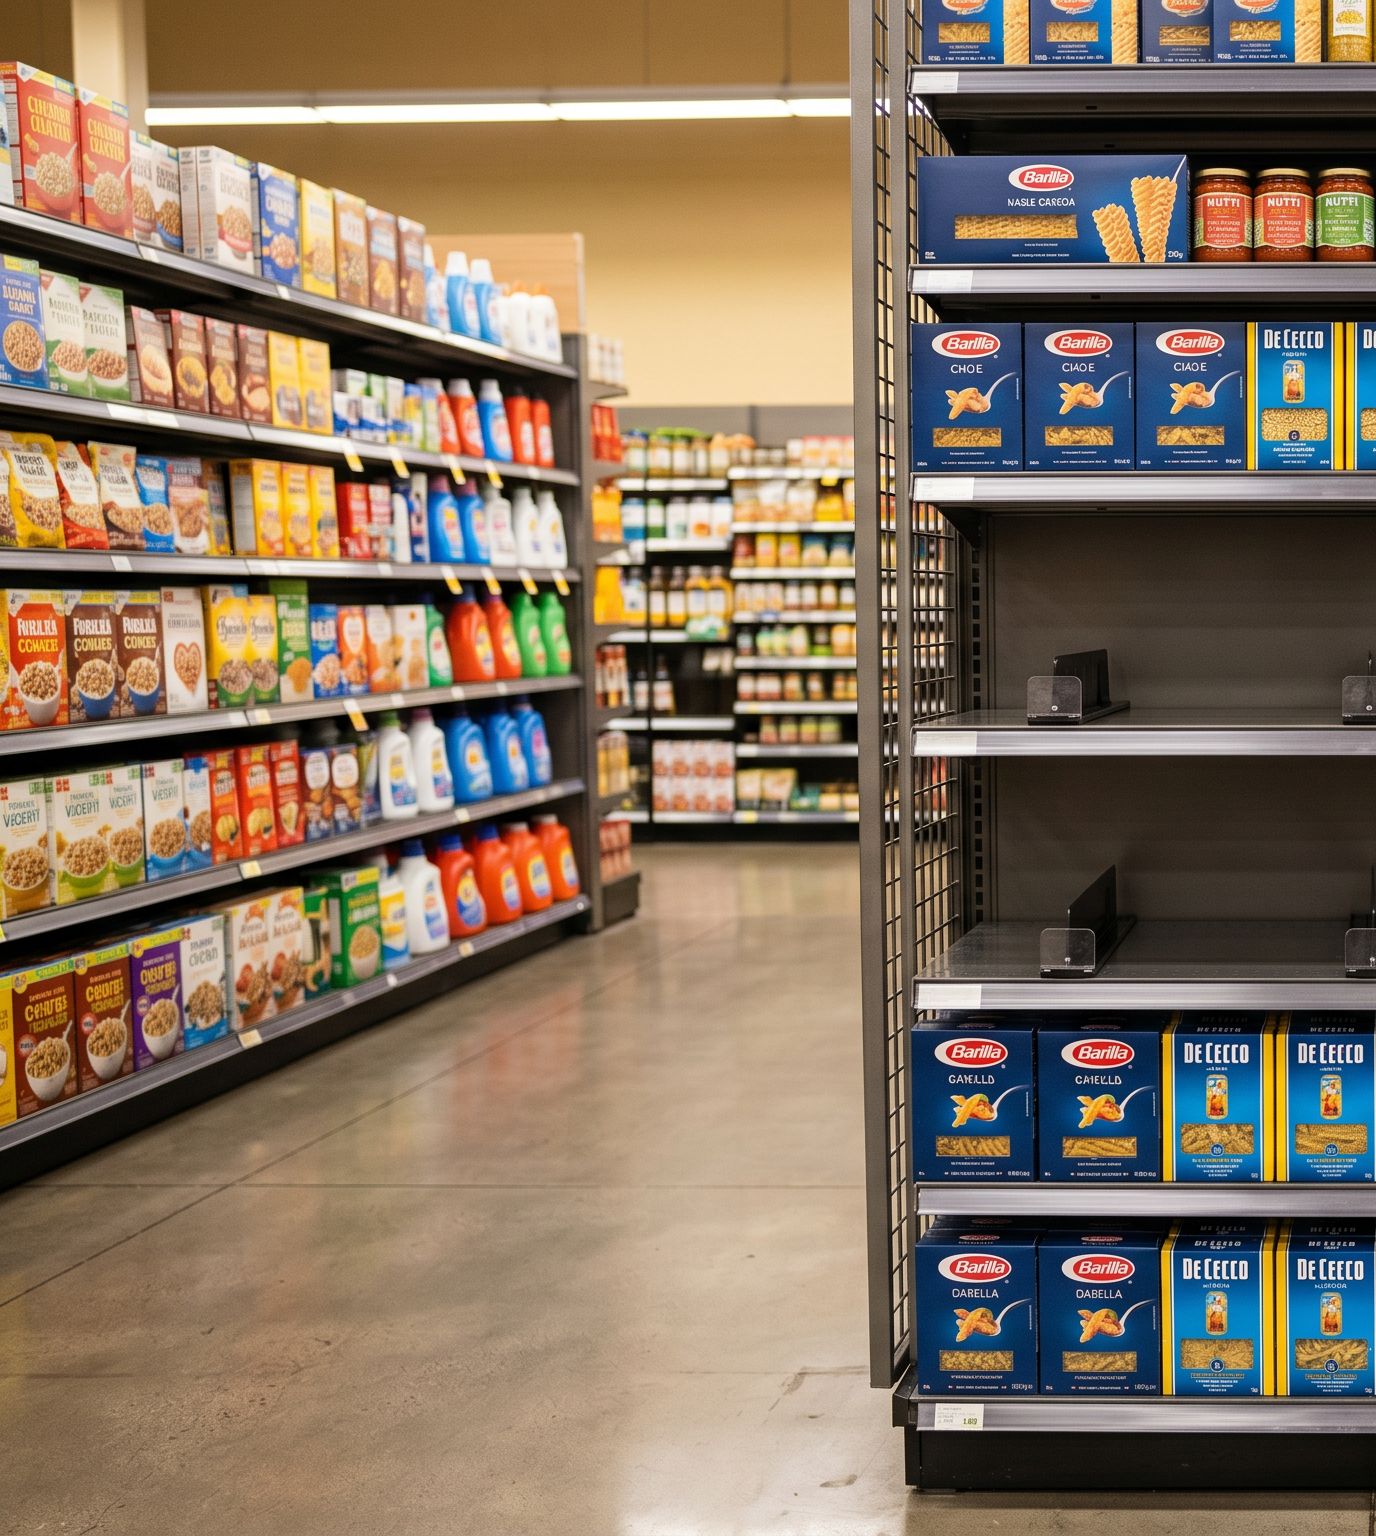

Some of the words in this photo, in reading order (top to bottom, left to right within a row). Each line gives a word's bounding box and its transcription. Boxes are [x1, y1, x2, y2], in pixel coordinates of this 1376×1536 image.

[1023, 171, 1069, 184] Barilla
[946, 336, 995, 350] Barilla
[1058, 335, 1107, 349] Barilla
[1170, 335, 1219, 349] Barilla
[951, 1044, 1002, 1059] Barilla
[1078, 1045, 1128, 1060] Barilla
[955, 1260, 1005, 1274] Barilla
[1078, 1260, 1129, 1275] Barilla
[1204, 1258, 1249, 1280] CECCO
